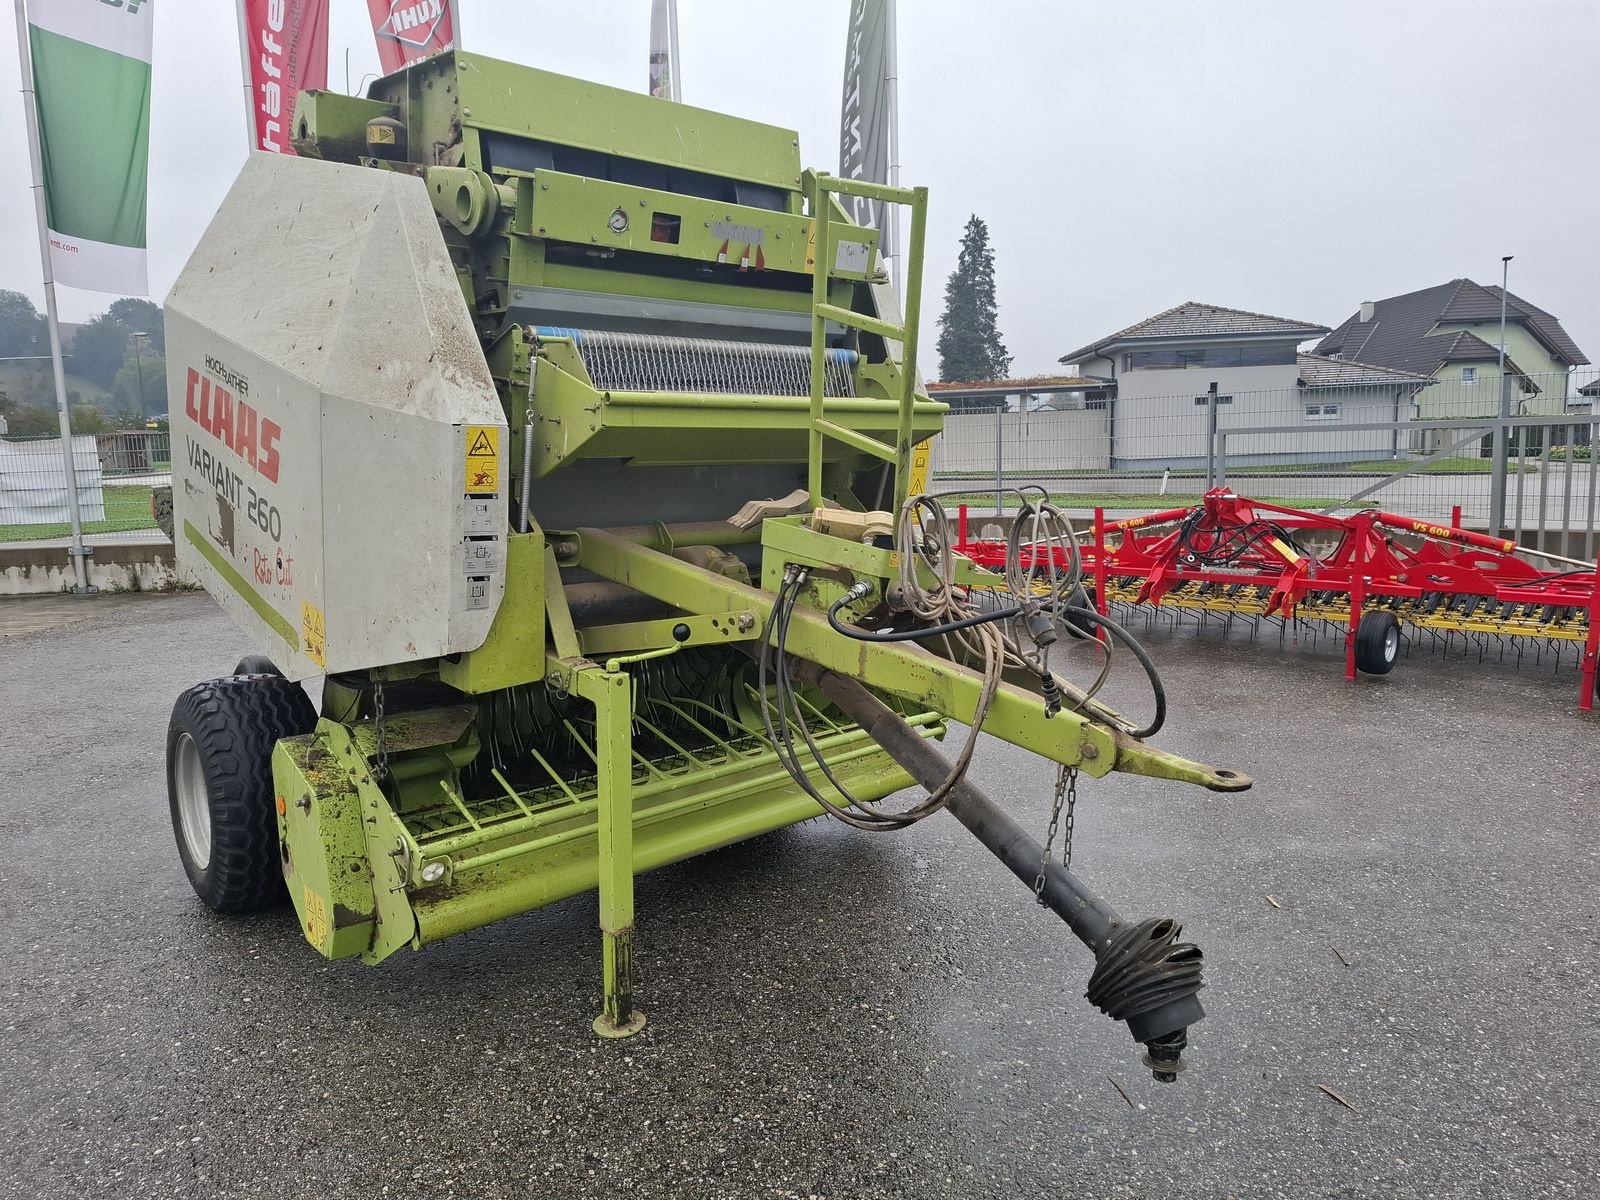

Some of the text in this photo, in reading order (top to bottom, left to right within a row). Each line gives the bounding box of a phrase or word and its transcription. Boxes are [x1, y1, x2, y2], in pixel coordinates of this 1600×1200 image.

[262, 0, 284, 153] häffe
[184, 366, 282, 484] CLAAS
[185, 434, 282, 543] VARIANT 260
[1129, 518, 1145, 526] 600
[254, 546, 294, 585] Roto Cut
[1413, 522, 1428, 532] VS
[1429, 526, 1450, 538] 600
